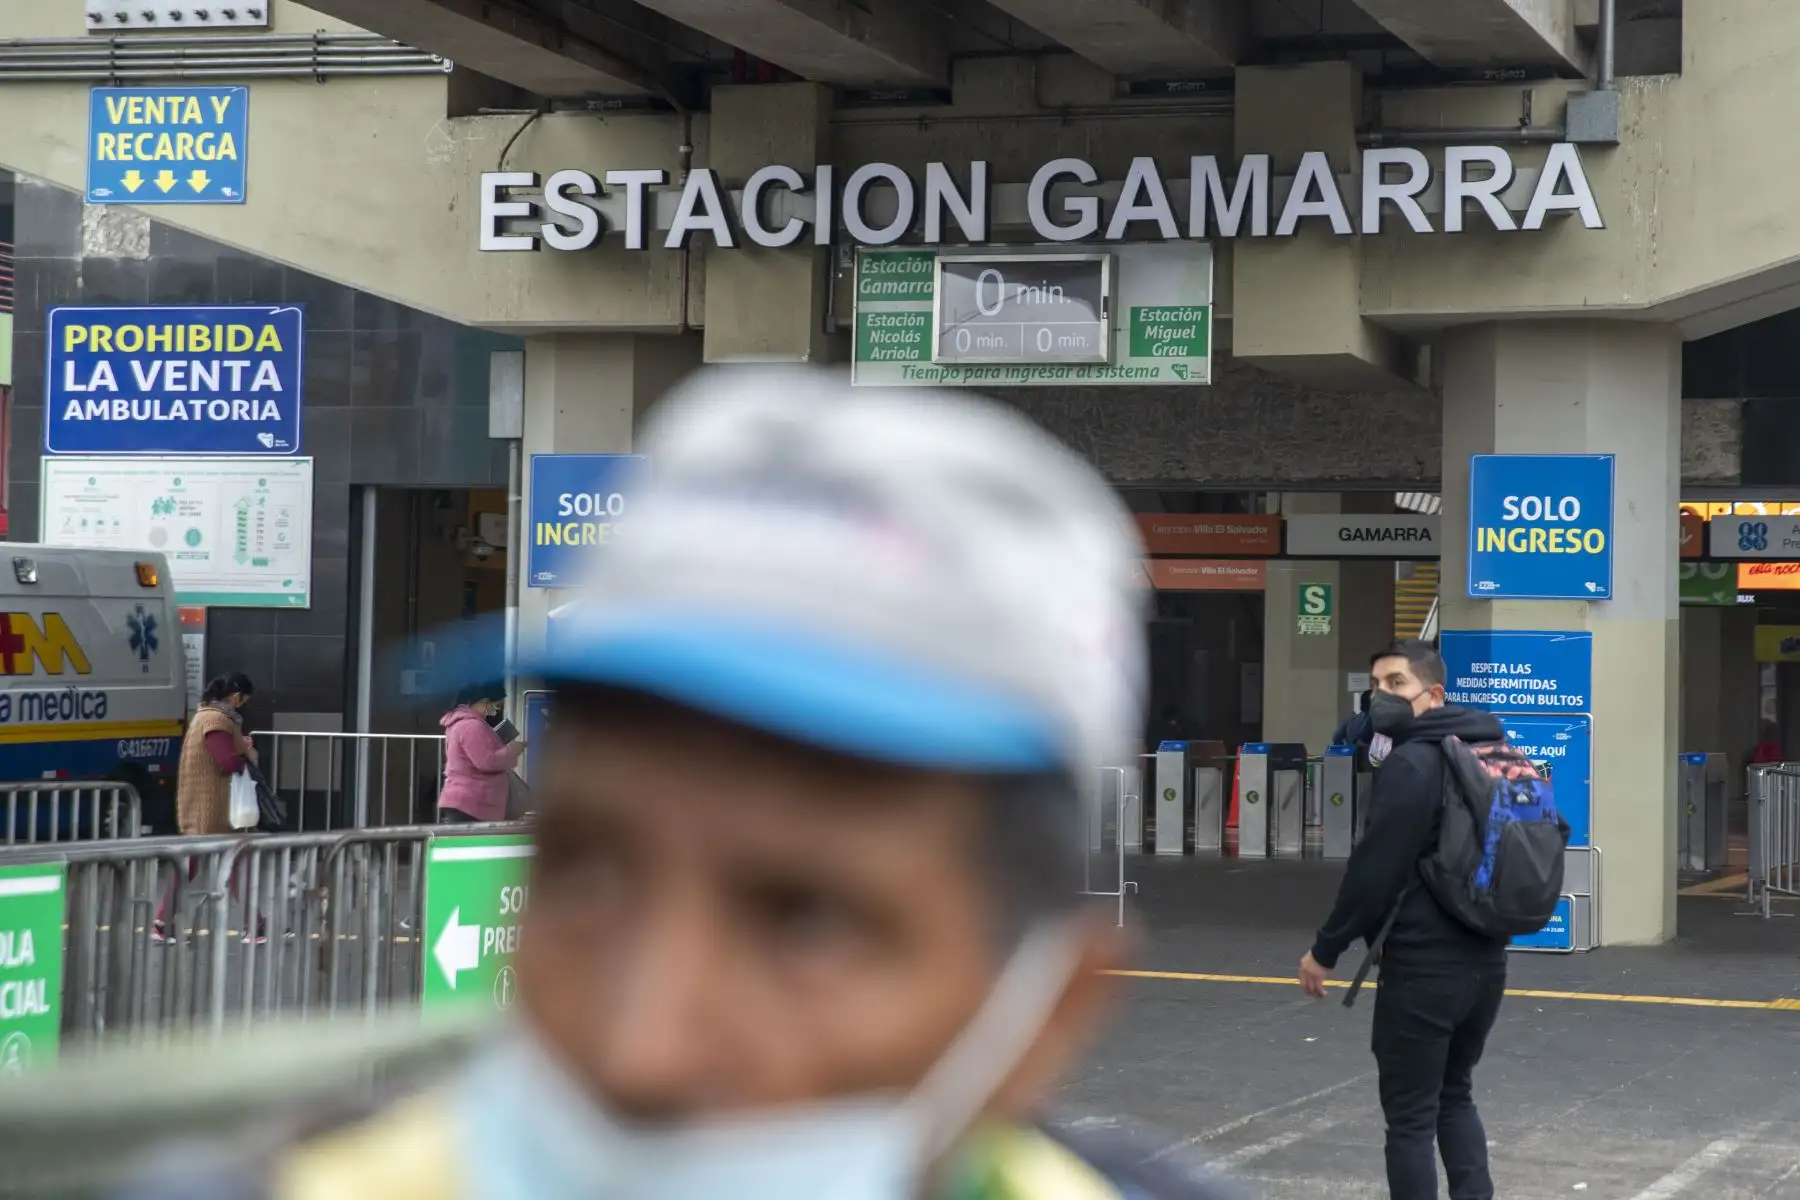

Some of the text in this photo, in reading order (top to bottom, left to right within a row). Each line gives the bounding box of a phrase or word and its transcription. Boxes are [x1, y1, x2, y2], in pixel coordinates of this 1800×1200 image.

[106, 96, 231, 124] VENTA Y
[97, 132, 237, 161] RECARGA
[479, 143, 1604, 251] ESTACION GAMARRA
[861, 257, 932, 274] Estación
[860, 278, 934, 294] Gamarra
[976, 268, 1071, 316] 0 min.
[866, 313, 924, 327] Estación
[1139, 307, 1202, 322] Estación
[64, 324, 283, 352] PROHIBIDA
[870, 330, 921, 344] Nicolás
[956, 328, 1008, 353] 0 min.
[1037, 328, 1090, 352] 0 min.
[1144, 325, 1196, 343] Miguel
[870, 347, 919, 360] Arriola
[1152, 344, 1188, 357] Grau
[64, 360, 283, 392] LA VENTA
[902, 365, 1160, 383] Tiempo para ingresar al sistema
[63, 399, 281, 421] AMBULATORIA
[558, 493, 624, 517] SOLO
[1502, 495, 1581, 522] SOLO
[536, 522, 624, 546] INGRE
[1226, 524, 1268, 534] Salvador
[1338, 527, 1432, 541] GAMARRA
[1477, 527, 1605, 554] INGRESO
[1304, 586, 1326, 614] S
[1471, 662, 1532, 674] RESPETA LAS
[1456, 678, 1557, 690] MEDIDAS PERMITIDAS
[1444, 692, 1583, 706] PARA EL INGRESO CON BULTOS
[1540, 745, 1566, 757] AQUÍ
